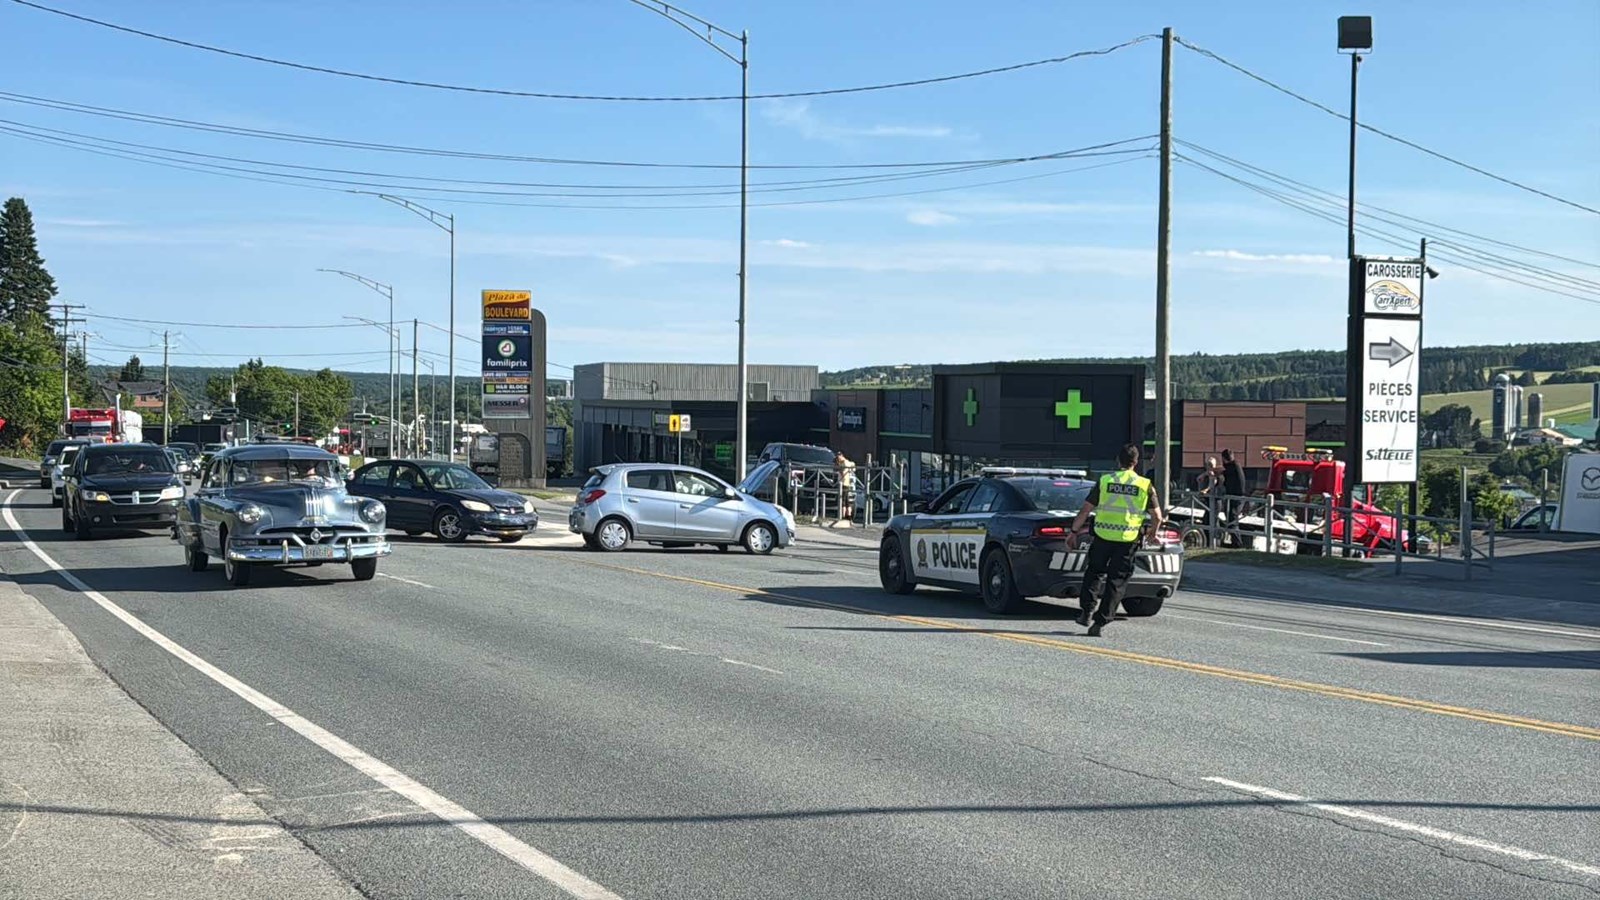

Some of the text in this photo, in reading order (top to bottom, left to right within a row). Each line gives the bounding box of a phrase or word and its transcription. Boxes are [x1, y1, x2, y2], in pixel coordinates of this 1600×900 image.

[1367, 264, 1420, 279] CAROSSERIE
[488, 293, 515, 301] Plaza
[485, 307, 529, 318] BOULEVARD
[486, 358, 528, 369] familiprix
[1369, 380, 1413, 396] PIÈCES
[1364, 409, 1416, 423] SERVICE
[1108, 484, 1138, 495] POLICE
[932, 541, 977, 570] POLICE
